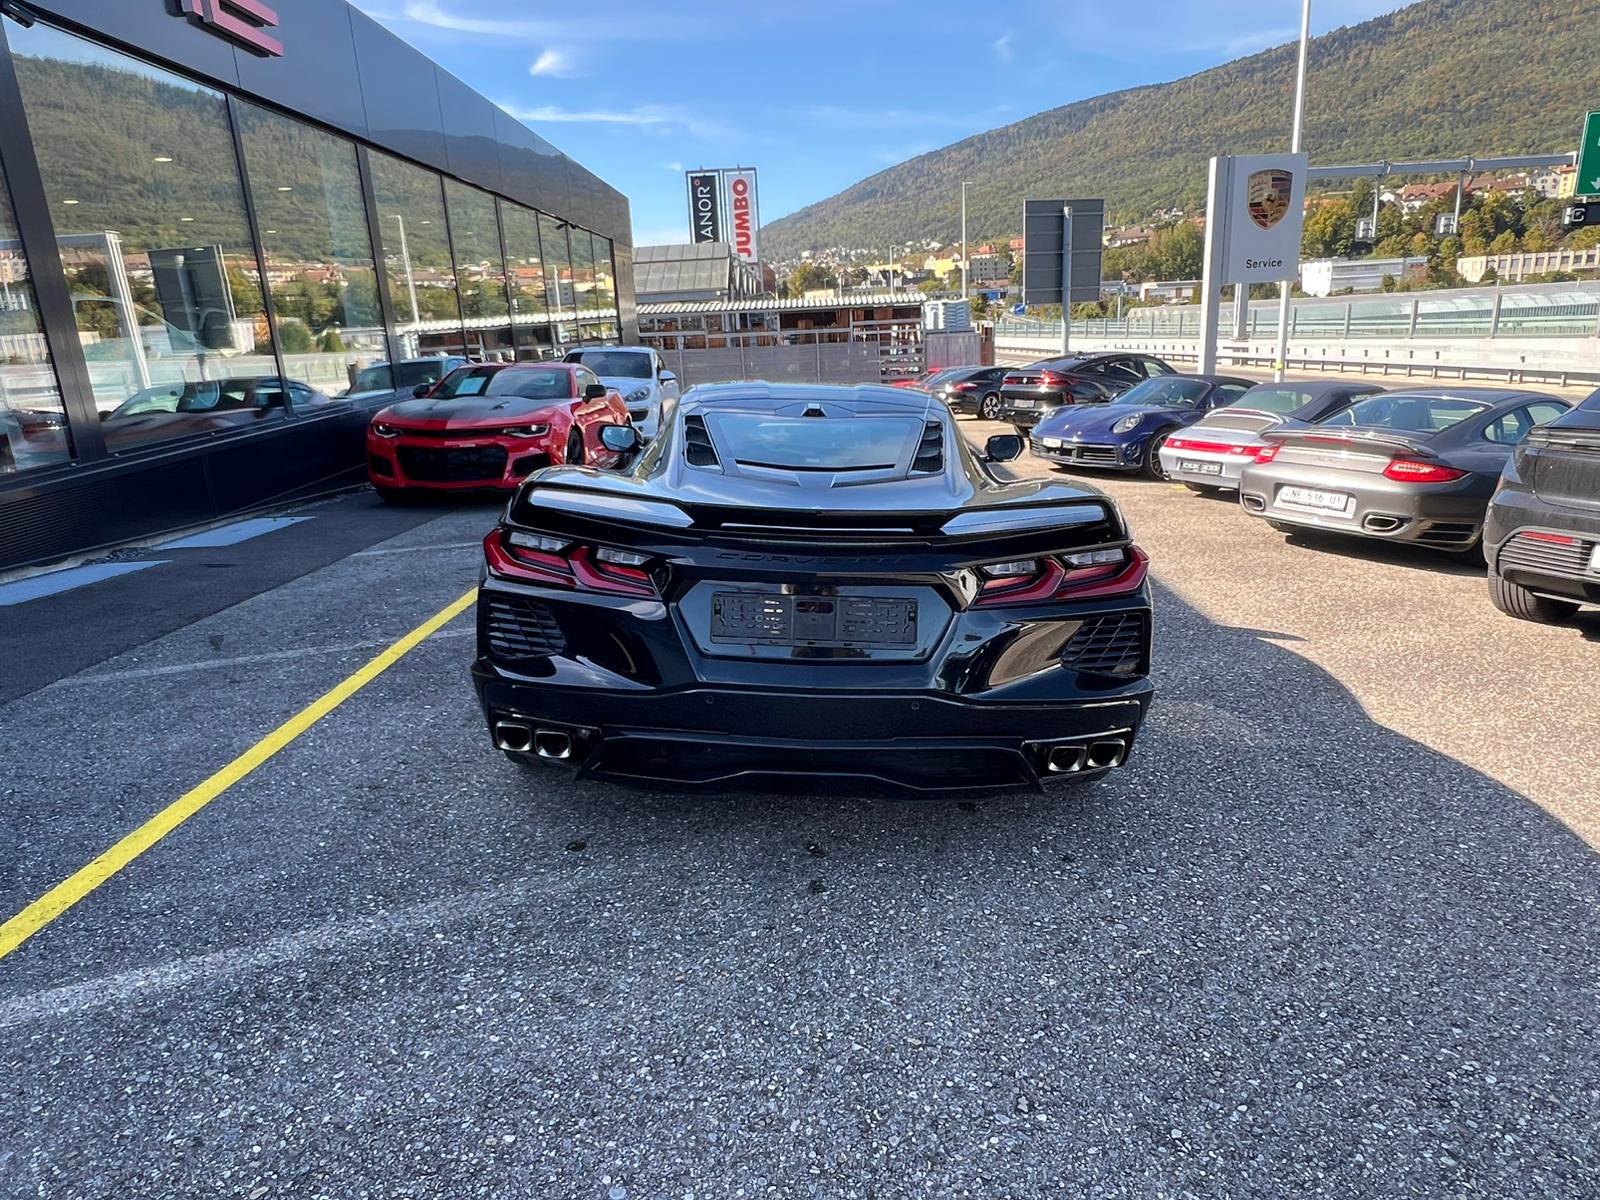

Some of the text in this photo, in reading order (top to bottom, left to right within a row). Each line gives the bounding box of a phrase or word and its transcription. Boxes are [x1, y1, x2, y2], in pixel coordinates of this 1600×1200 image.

[697, 186, 714, 243] ANOR
[732, 178, 752, 257] JUMBO
[1246, 258, 1283, 269] Service
[715, 551, 914, 566] CORVETTE
